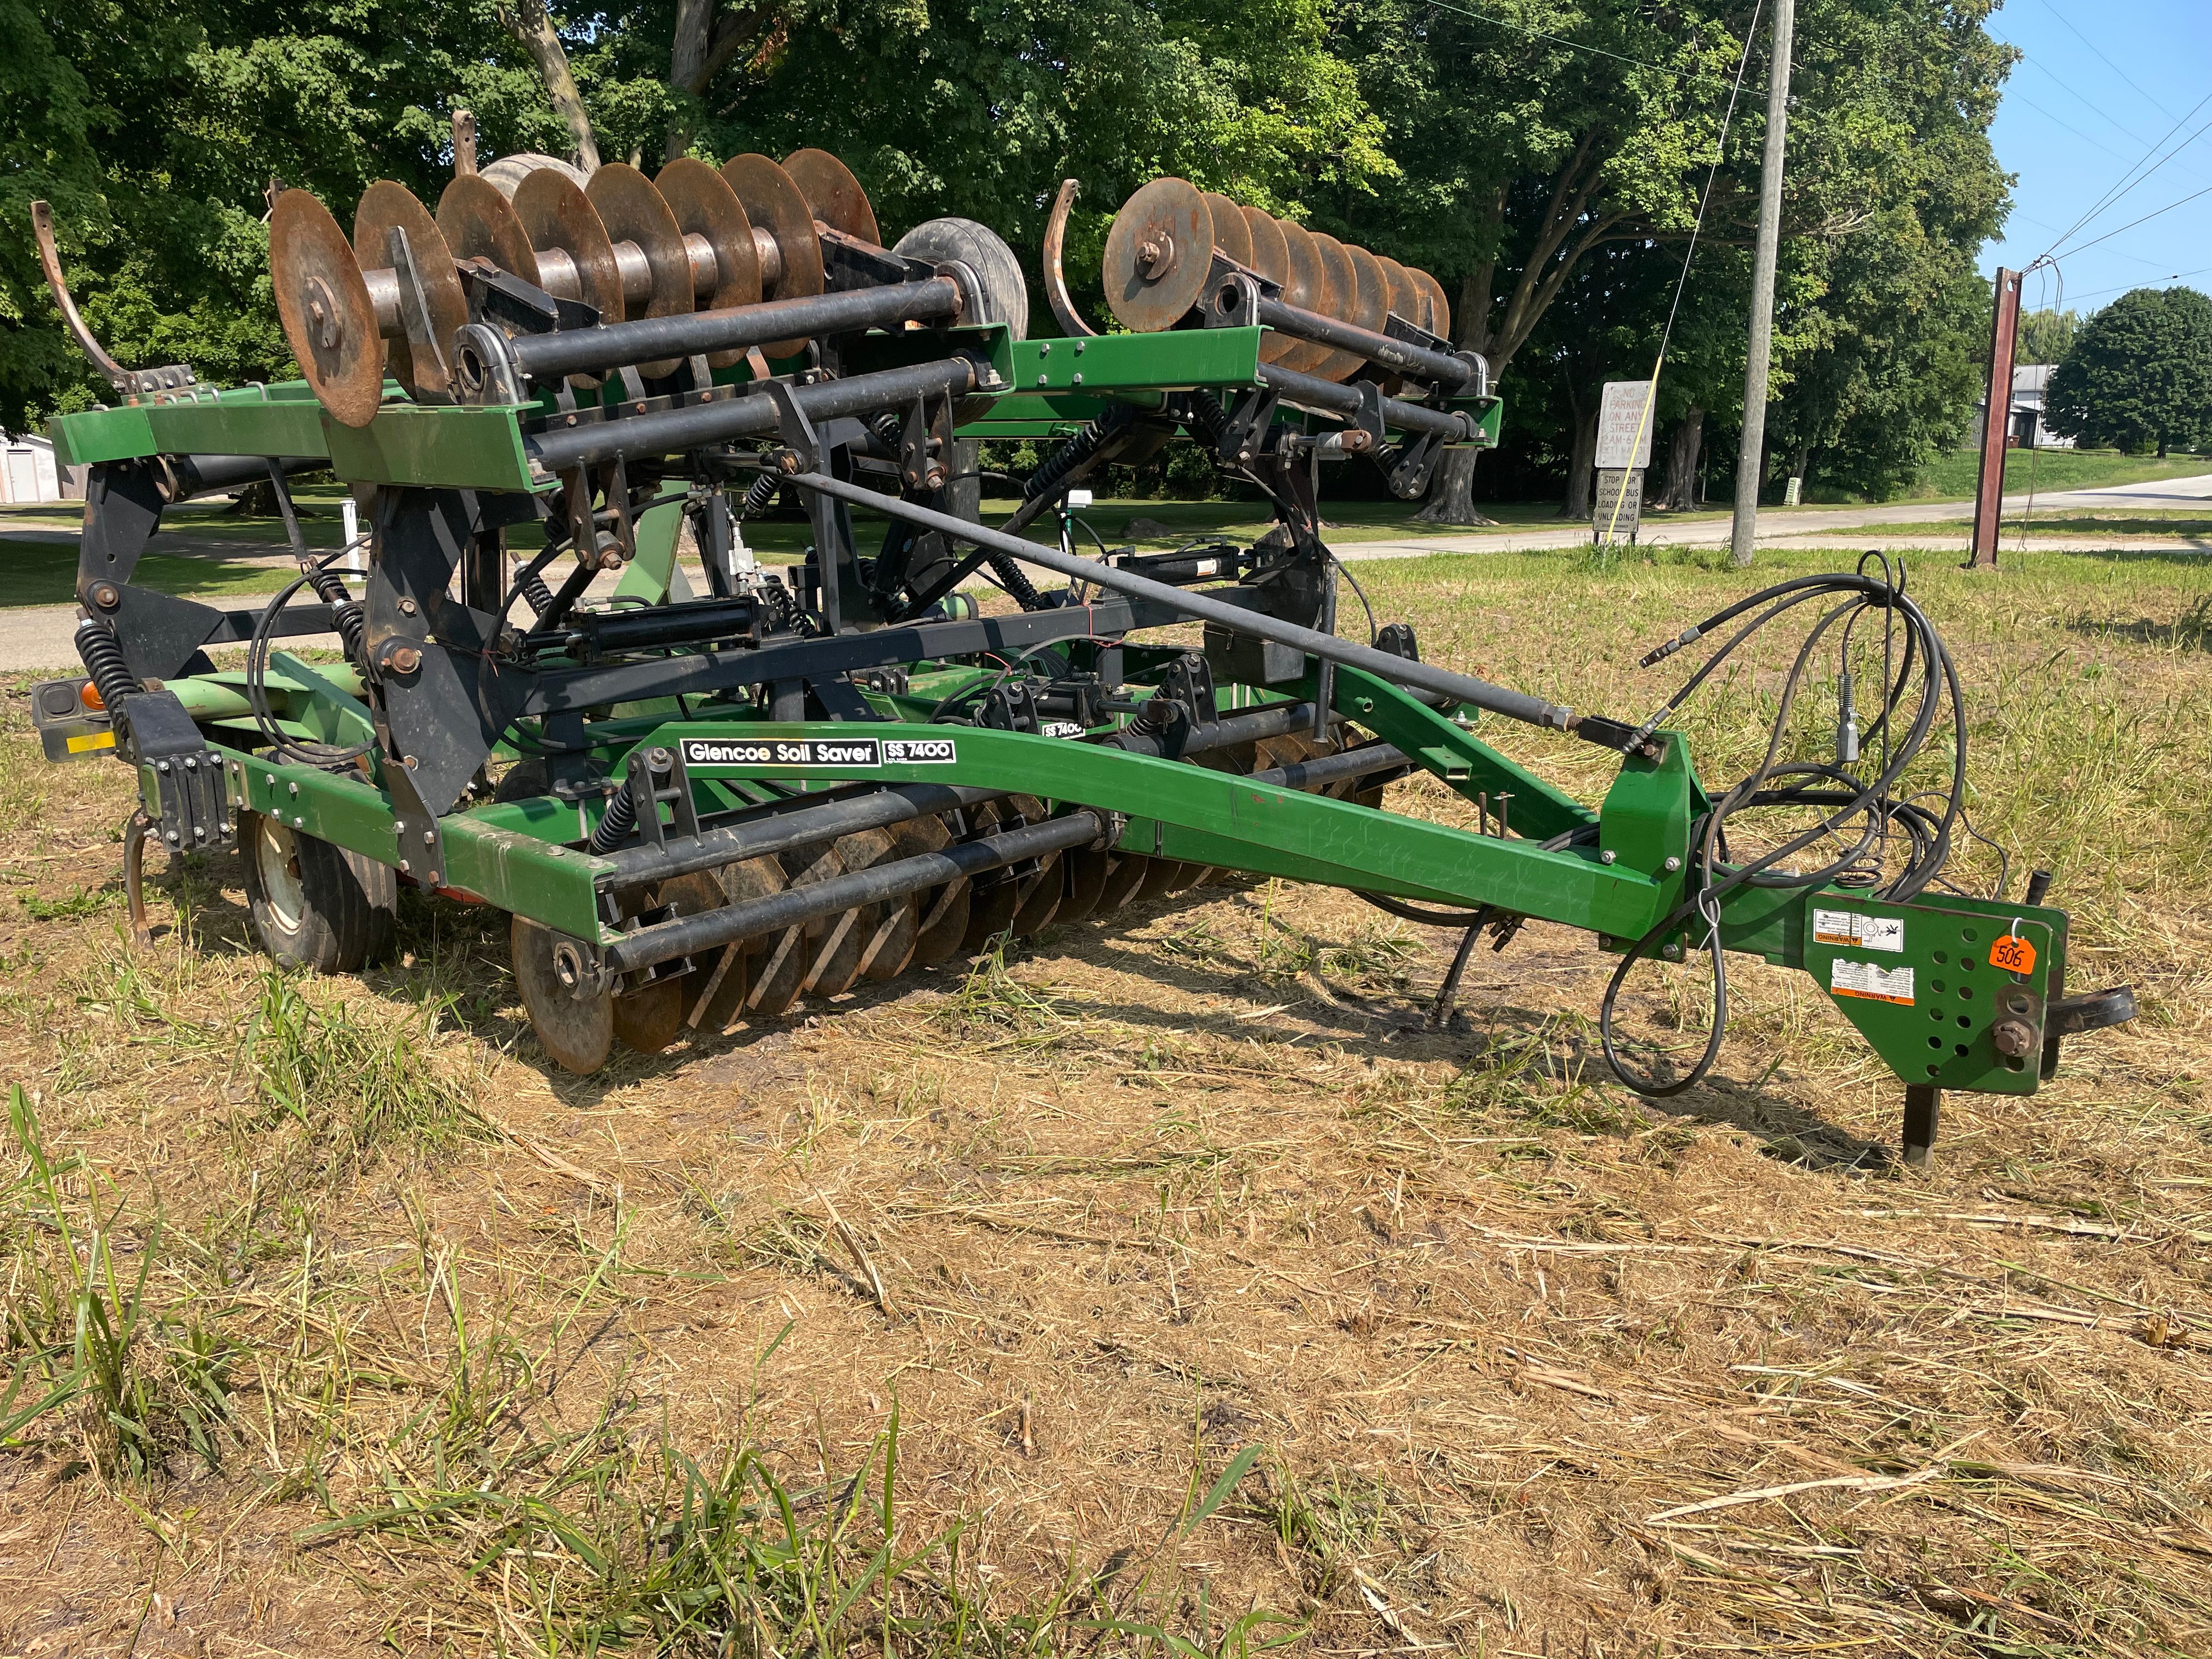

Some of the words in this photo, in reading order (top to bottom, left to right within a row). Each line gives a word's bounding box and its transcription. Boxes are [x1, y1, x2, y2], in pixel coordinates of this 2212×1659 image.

[1623, 388, 1634, 398] NO
[1610, 400, 1646, 409] PARKING
[1609, 412, 1621, 421] ON
[1624, 412, 1644, 421] ANY
[1610, 423, 1641, 433] STREET
[1624, 476, 1636, 484] OR
[1598, 500, 1625, 509] LOADIG
[1046, 726, 1056, 737] SS
[689, 743, 771, 761] Glencoe
[777, 744, 811, 761] Soil
[816, 744, 871, 761] Saver
[888, 743, 905, 757] SS
[907, 743, 950, 757] 7400
[1818, 934, 1849, 943] WARNING
[1996, 945, 2024, 967] 506
[1854, 991, 1887, 1000] WARNING
